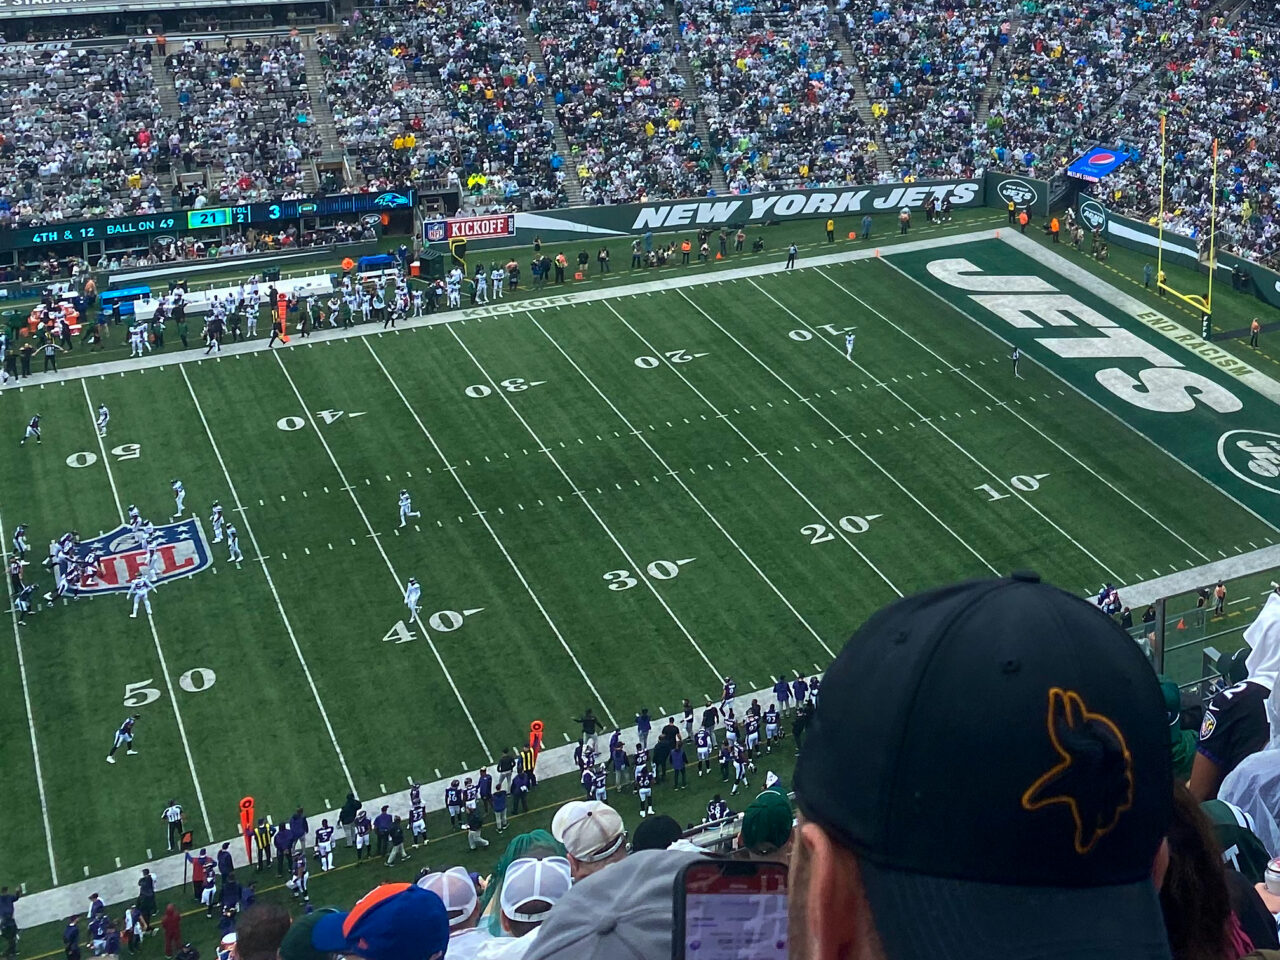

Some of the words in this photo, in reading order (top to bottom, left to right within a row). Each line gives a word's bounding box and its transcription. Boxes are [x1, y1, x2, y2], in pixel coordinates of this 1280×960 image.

[632, 200, 744, 230] NEW
[750, 190, 870, 220] YORK
[872, 182, 980, 210] JETS
[1002, 189, 1032, 201] JETS
[200, 212, 217, 224] 21
[232, 206, 247, 214] TOL
[236, 214, 244, 224] 2
[269, 204, 280, 220] 3
[33, 232, 58, 242] 4TH
[64, 230, 73, 240] &
[80, 228, 94, 238] 12
[107, 224, 136, 234] BALL
[138, 221, 156, 230] ON
[159, 218, 174, 228] 49
[452, 219, 504, 236] KICKOFF
[462, 294, 578, 318] KICKOFF
[926, 258, 1243, 414] JETS
[1136, 312, 1177, 332] END
[1174, 334, 1254, 378] RACISM
[974, 473, 1041, 502] 10
[800, 514, 871, 546] 20
[602, 560, 680, 592] 30
[382, 608, 464, 644] 40
[123, 667, 216, 708] 50
